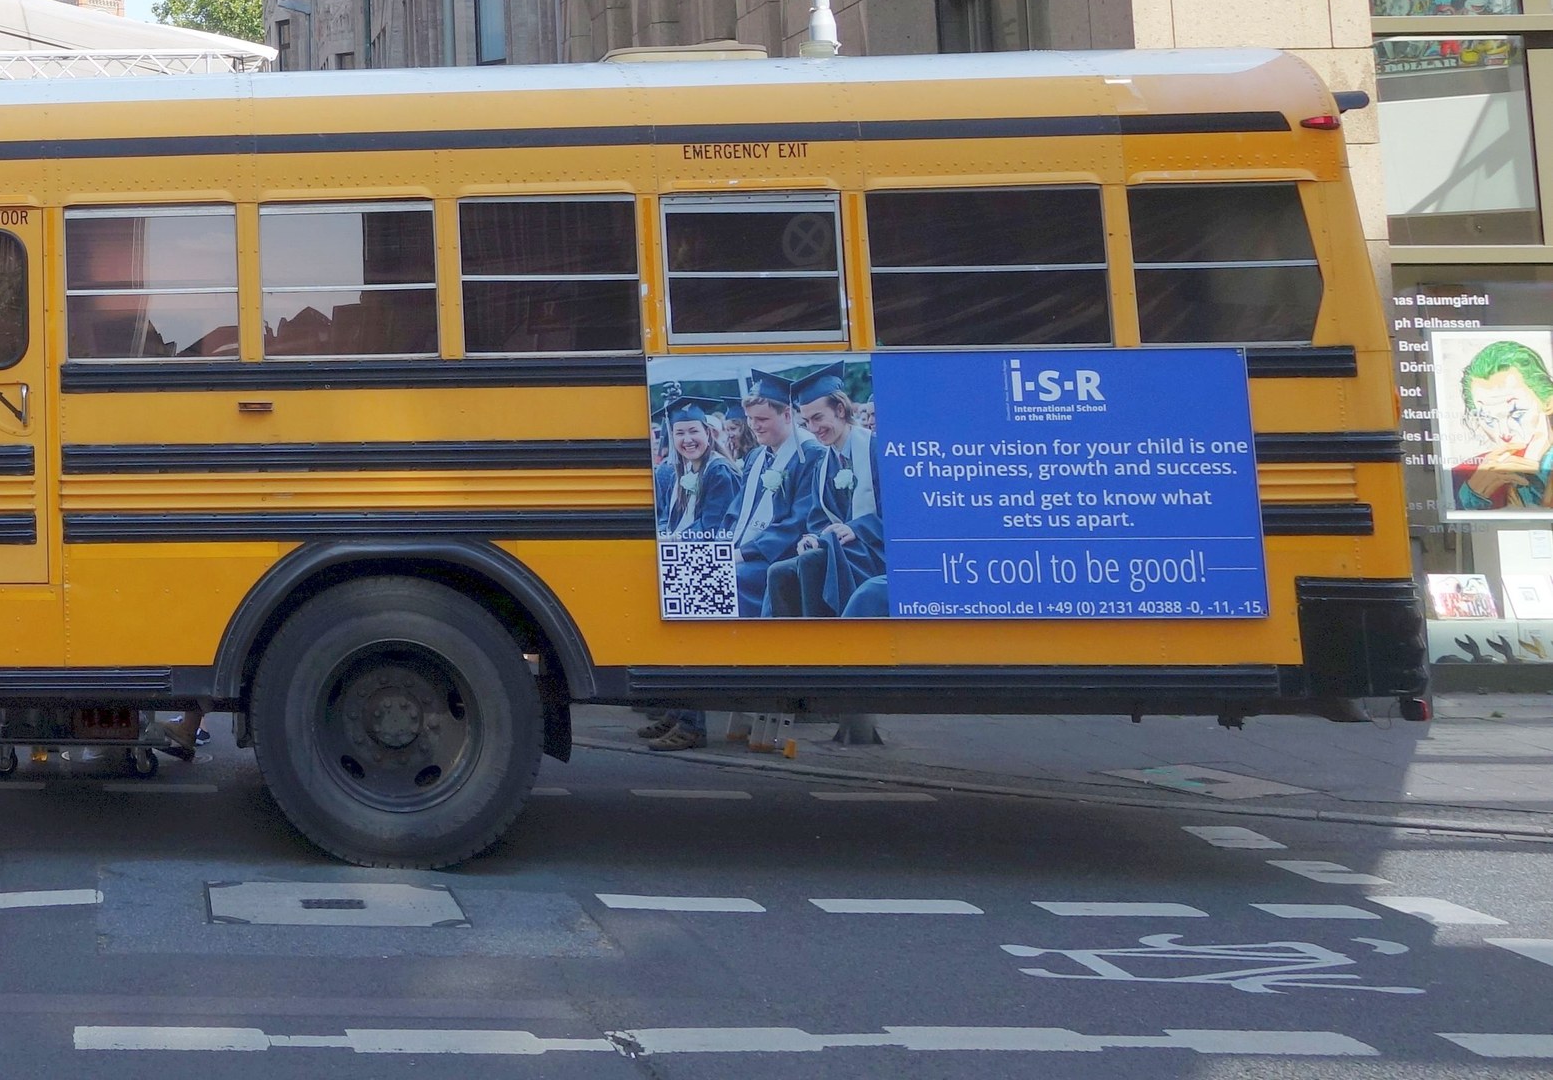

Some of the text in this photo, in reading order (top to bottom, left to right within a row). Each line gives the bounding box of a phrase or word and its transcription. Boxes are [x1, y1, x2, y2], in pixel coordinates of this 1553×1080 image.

[1385, 58, 1459, 73] DOLLAR
[683, 143, 808, 160] EMERGENCY EXIT
[1417, 294, 1489, 307] Baumgärtel
[1415, 317, 1480, 328] Belhassen
[1399, 341, 1429, 351] Bred
[1400, 386, 1422, 397] bot
[1014, 404, 1107, 413] International School
[1028, 413, 1044, 421] the
[1046, 413, 1072, 421] Rhine
[884, 438, 1248, 459] At ISR, our vision for your child is one
[1405, 454, 1424, 465] shi
[904, 460, 1237, 481] of happiness, growth and success.
[923, 489, 1212, 510] Visit us and get to know what
[1003, 513, 1135, 531] sets us apart.
[988, 550, 1042, 584] cool
[1050, 553, 1077, 583] to
[1086, 550, 1120, 583] be
[1129, 550, 1207, 593] good!
[899, 601, 1034, 615] Info@isr-school.de
[1046, 602, 1073, 614] +49
[1077, 601, 1095, 615] (0)
[1099, 602, 1133, 613] 2131
[1138, 602, 1182, 613] 40388
[1186, 601, 1204, 615] -0,
[1207, 601, 1235, 615] -11,
